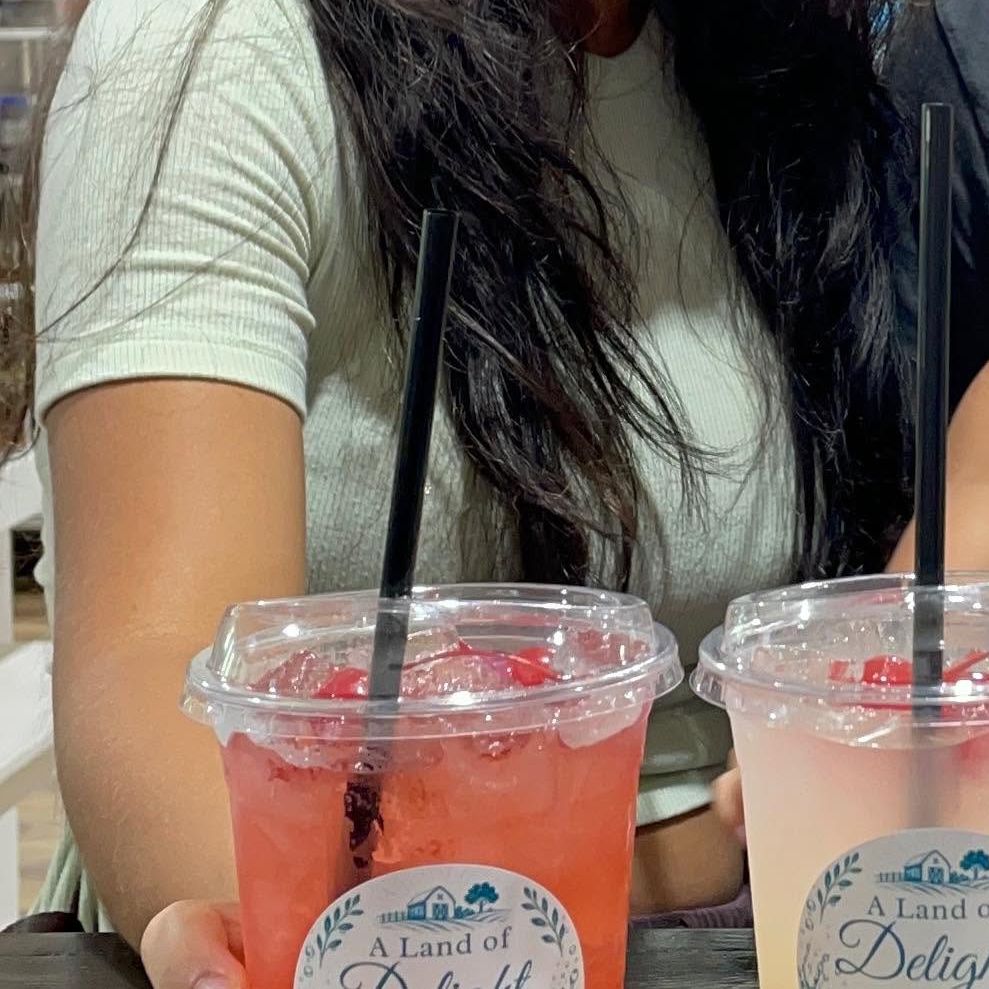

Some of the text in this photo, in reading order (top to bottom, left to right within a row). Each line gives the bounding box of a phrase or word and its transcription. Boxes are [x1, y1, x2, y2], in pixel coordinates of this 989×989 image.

[867, 895, 886, 917] A
[897, 897, 966, 920] Land
[369, 926, 512, 958] A Land of
